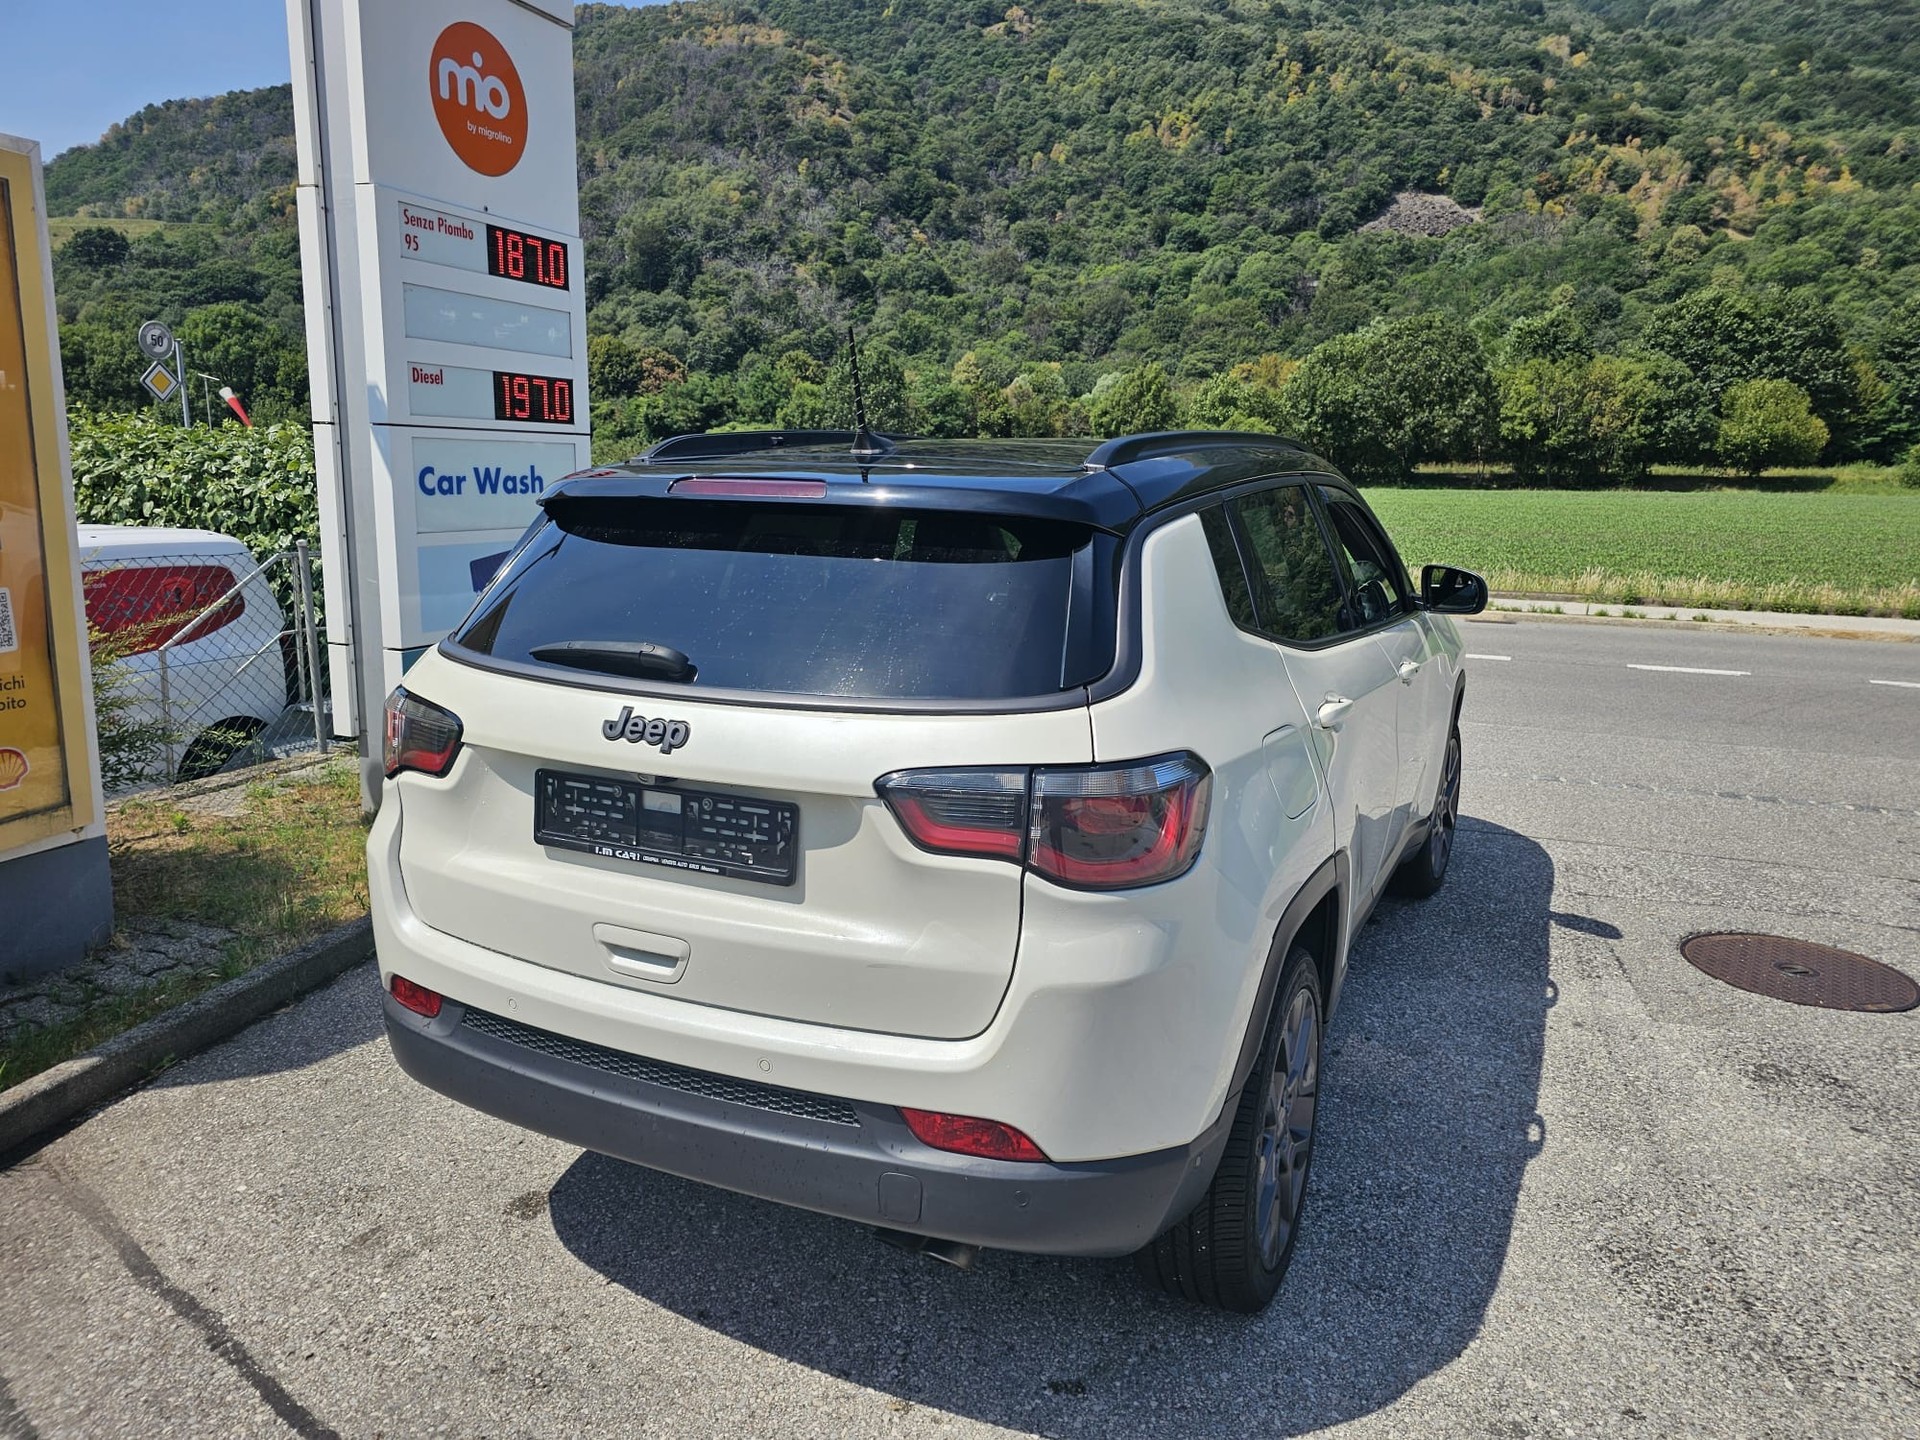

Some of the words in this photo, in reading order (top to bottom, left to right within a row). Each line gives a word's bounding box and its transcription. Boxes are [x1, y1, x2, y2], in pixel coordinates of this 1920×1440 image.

[438, 51, 511, 120] mio
[467, 120, 477, 134] by
[478, 126, 512, 145] migrolino
[403, 208, 435, 231] Senza
[437, 217, 474, 241] Piombo
[404, 233, 419, 252] 95
[495, 230, 566, 287] 187.0
[151, 334, 163, 347] 50
[412, 367, 443, 386] Diesel
[501, 375, 570, 421] 197.0
[418, 466, 466, 496] Car
[473, 464, 544, 495] Wash
[602, 705, 691, 755] Jeep
